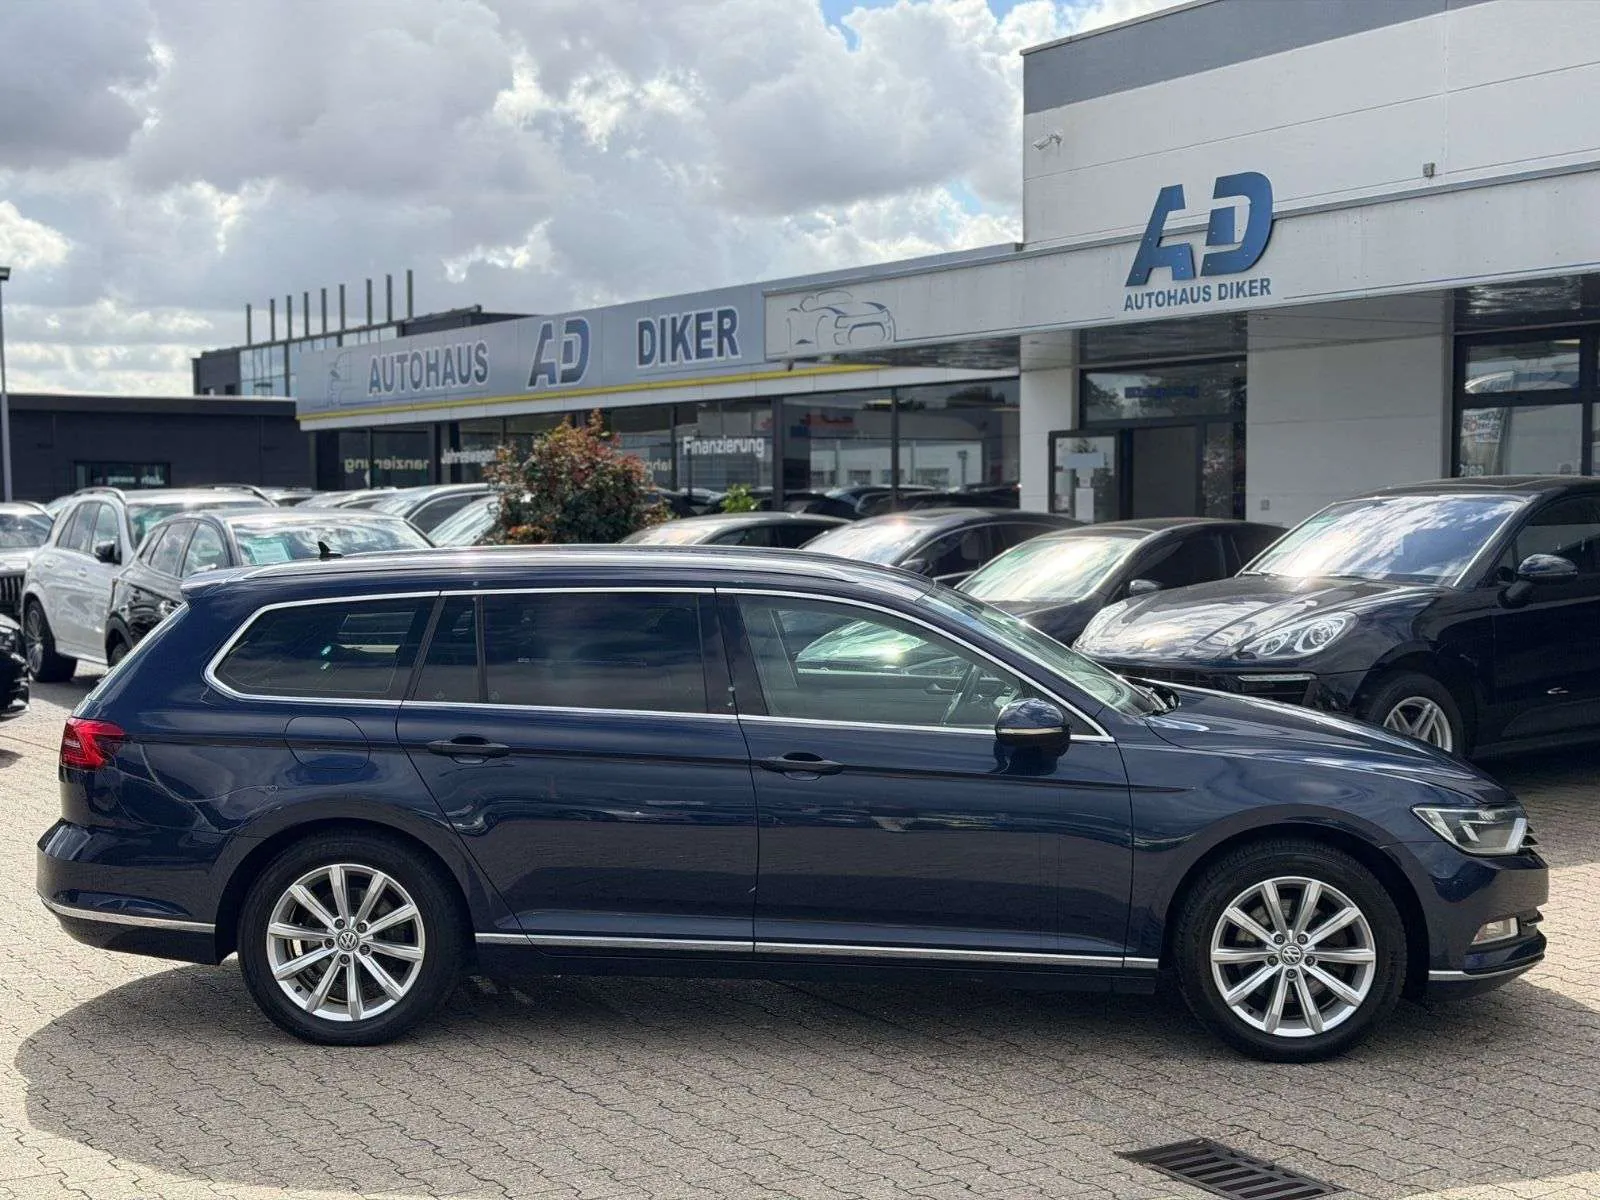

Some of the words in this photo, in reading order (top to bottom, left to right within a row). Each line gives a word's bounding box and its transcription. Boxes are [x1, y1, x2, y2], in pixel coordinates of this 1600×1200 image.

[1126, 171, 1273, 287] AD
[1125, 285, 1212, 312] AUTOHAUS
[1218, 278, 1272, 301] DIKER
[369, 342, 489, 395] AUTOHAUS
[528, 317, 591, 389] AD
[637, 306, 740, 368] DIKER
[683, 434, 765, 458] Finanzierung
